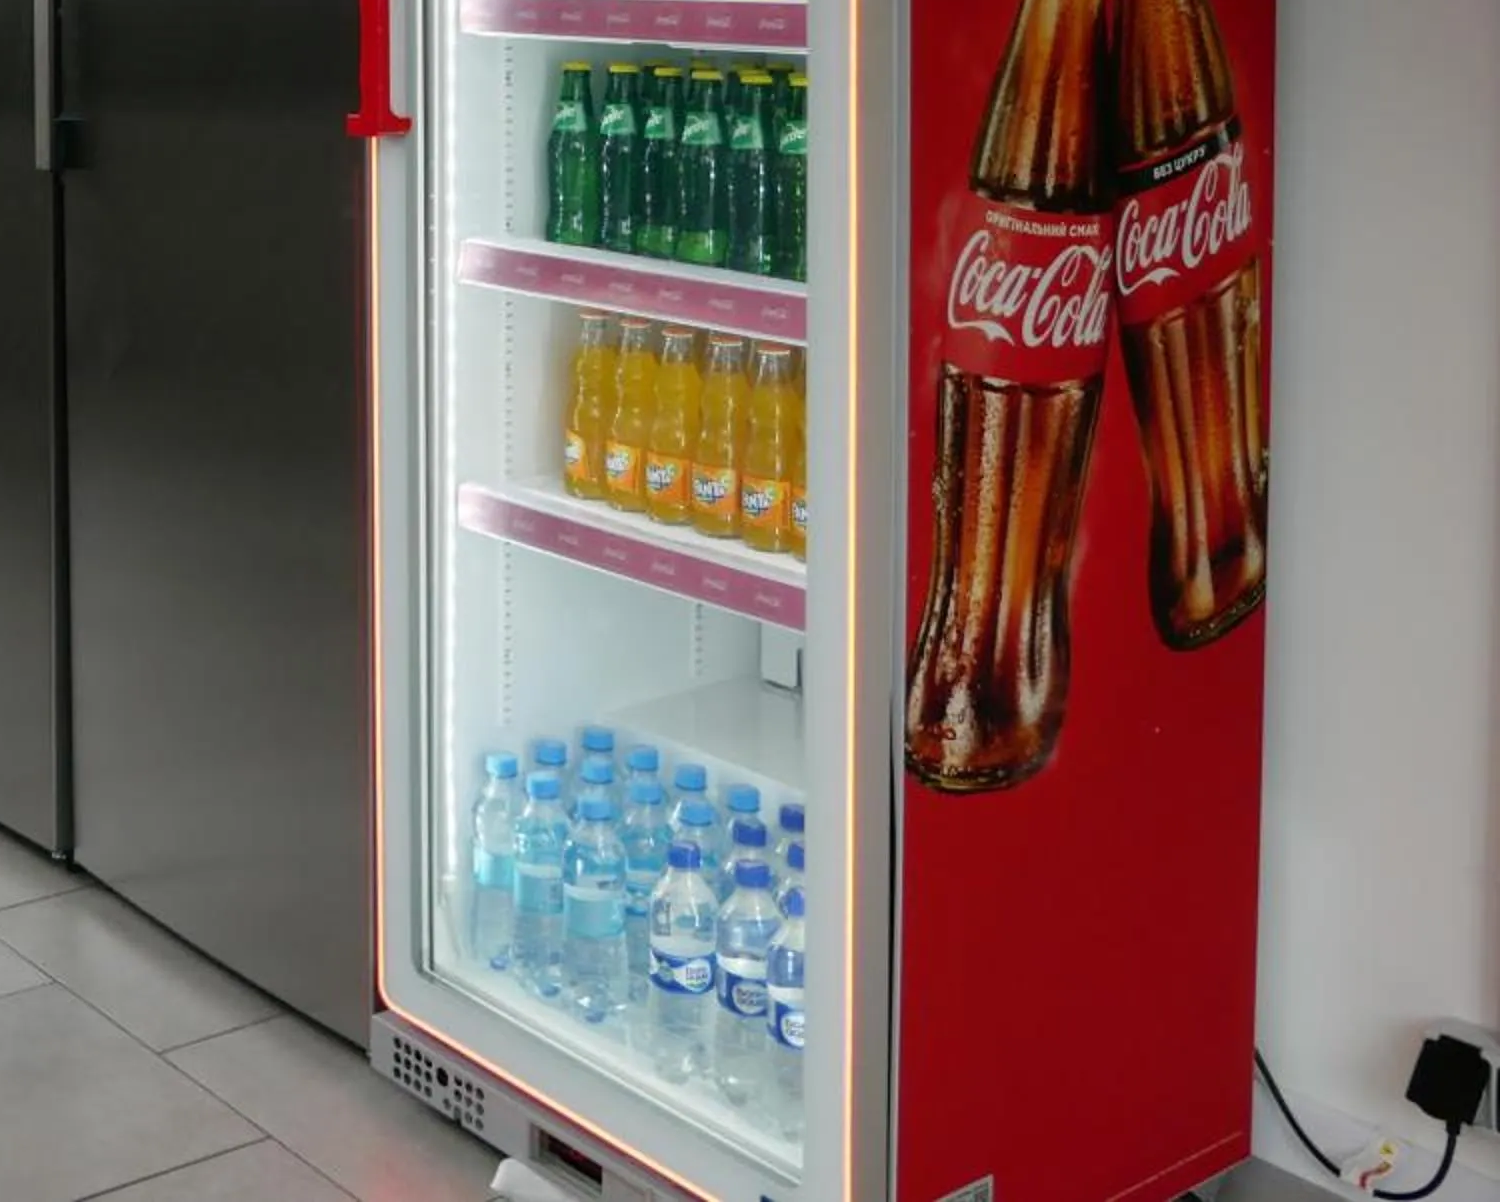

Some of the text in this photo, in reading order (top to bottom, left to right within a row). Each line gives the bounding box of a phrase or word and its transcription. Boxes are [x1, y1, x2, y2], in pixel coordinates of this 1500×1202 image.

[1069, 222, 1100, 237] СМАК
[1115, 141, 1251, 297] Coca-Cola
[948, 229, 1112, 348] Coca-Cola
